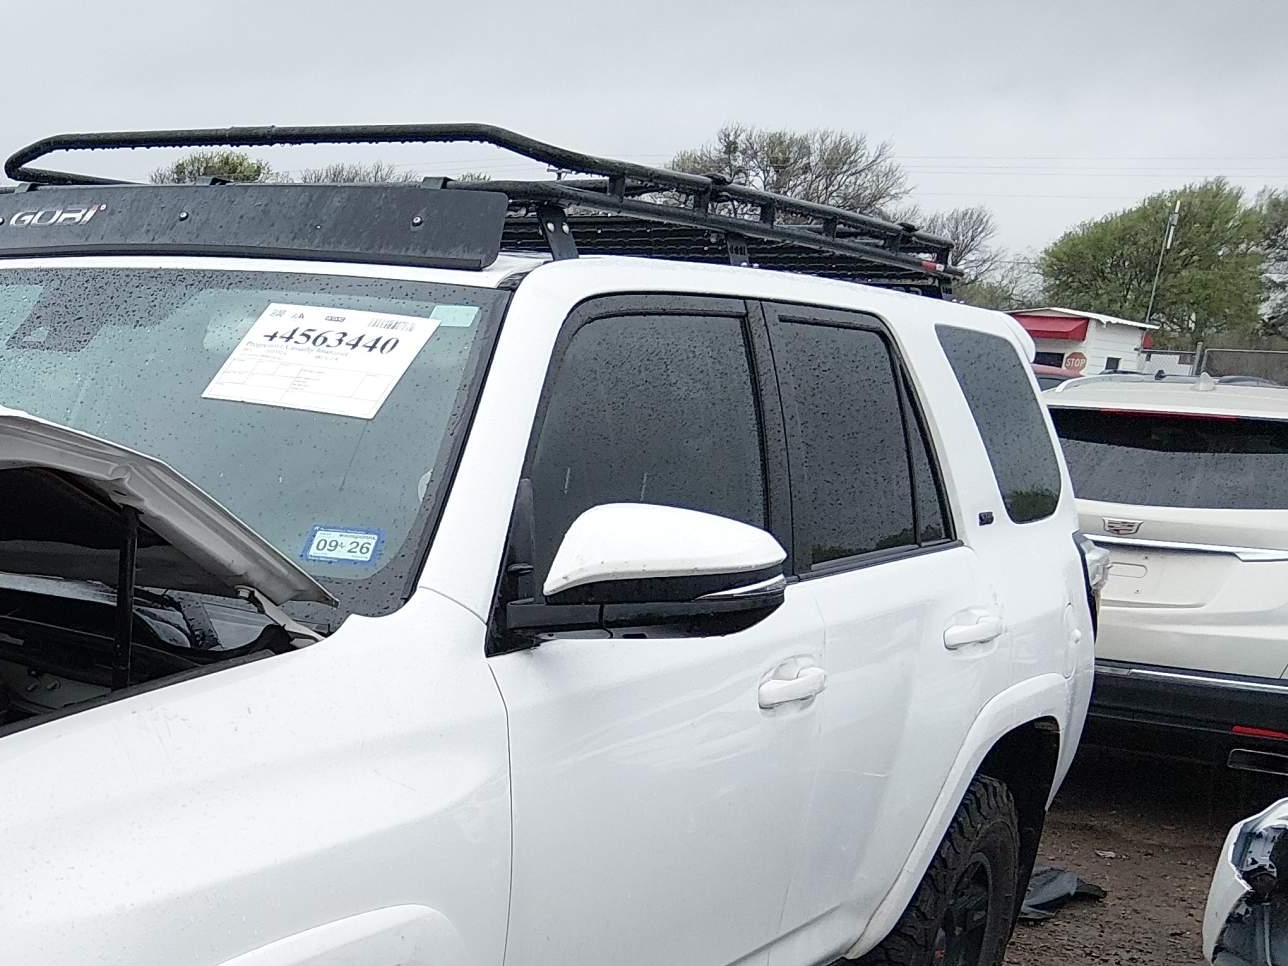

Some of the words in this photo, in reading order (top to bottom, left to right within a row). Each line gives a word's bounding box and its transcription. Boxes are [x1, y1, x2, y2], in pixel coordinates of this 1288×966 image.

[10, 203, 100, 225] GOBI
[1066, 358, 1086, 367] STOP
[316, 538, 339, 552] 09
[347, 541, 372, 555] 26
